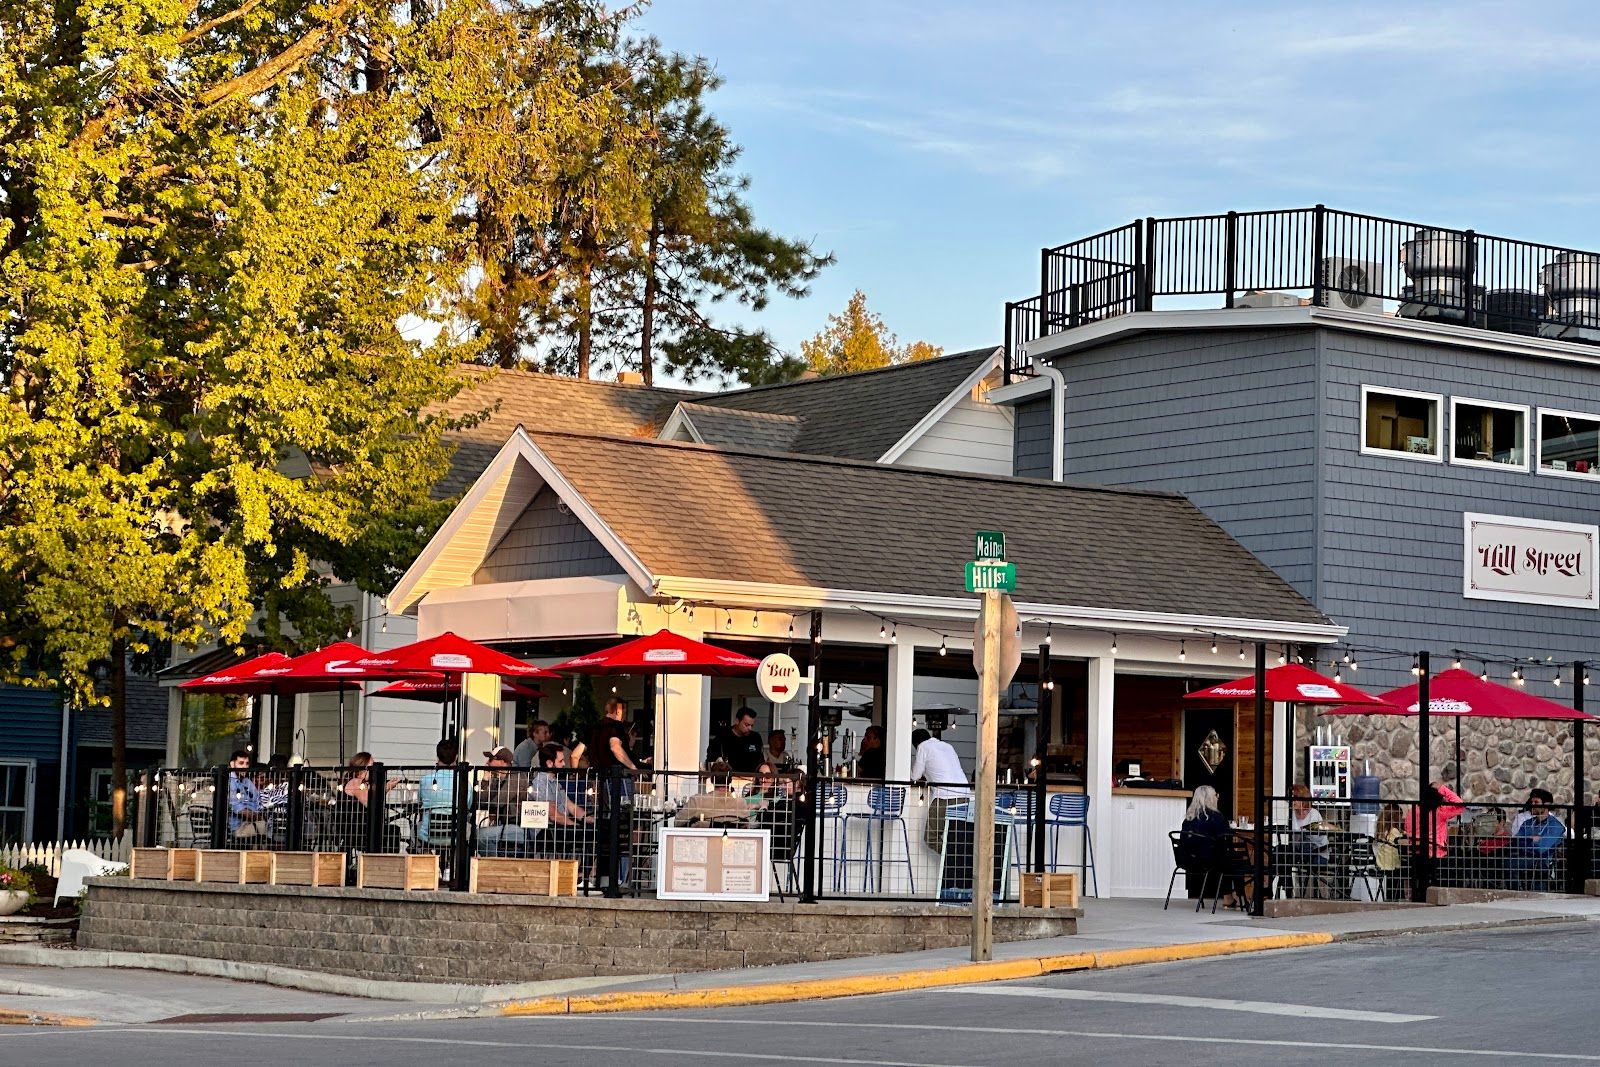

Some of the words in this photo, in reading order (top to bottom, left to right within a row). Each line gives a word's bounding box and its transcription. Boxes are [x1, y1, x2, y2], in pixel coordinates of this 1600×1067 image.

[977, 535, 998, 557] Main
[1478, 543, 1519, 576] Hill
[1523, 547, 1586, 577] Street
[972, 566, 998, 588] Hill
[766, 661, 795, 677] Bar
[524, 809, 547, 817] HIRING
